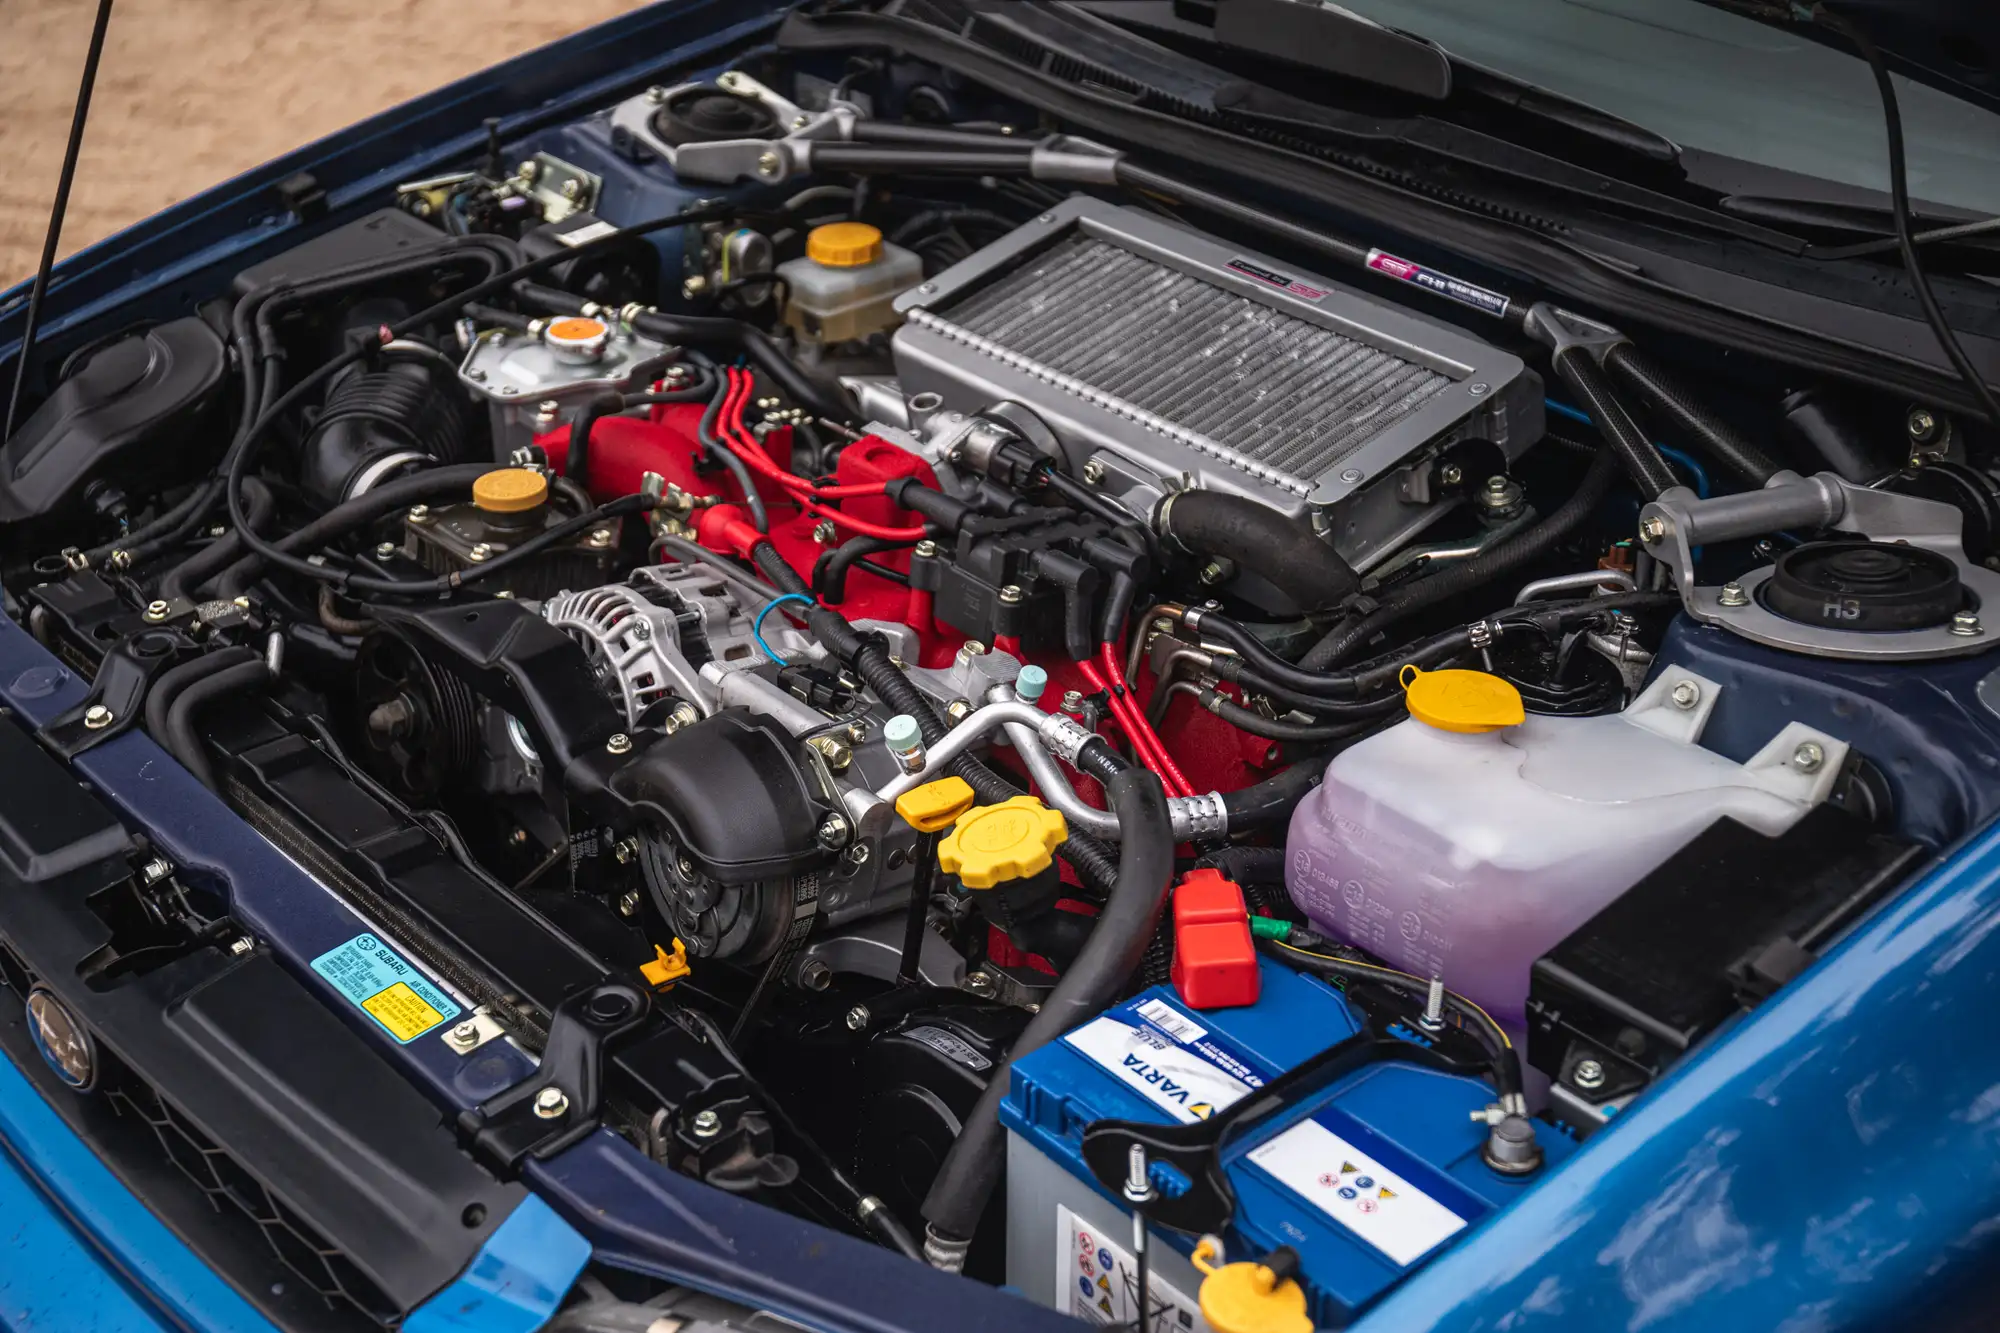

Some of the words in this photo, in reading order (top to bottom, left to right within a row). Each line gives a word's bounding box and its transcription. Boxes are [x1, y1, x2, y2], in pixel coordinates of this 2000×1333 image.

[375, 949, 408, 976] SUBARU
[405, 995, 427, 1014] CAUTION
[416, 985, 446, 1010] CONDITIONER
[1132, 1030, 1166, 1051] BLUE
[1123, 1053, 1189, 1104] VARTA
